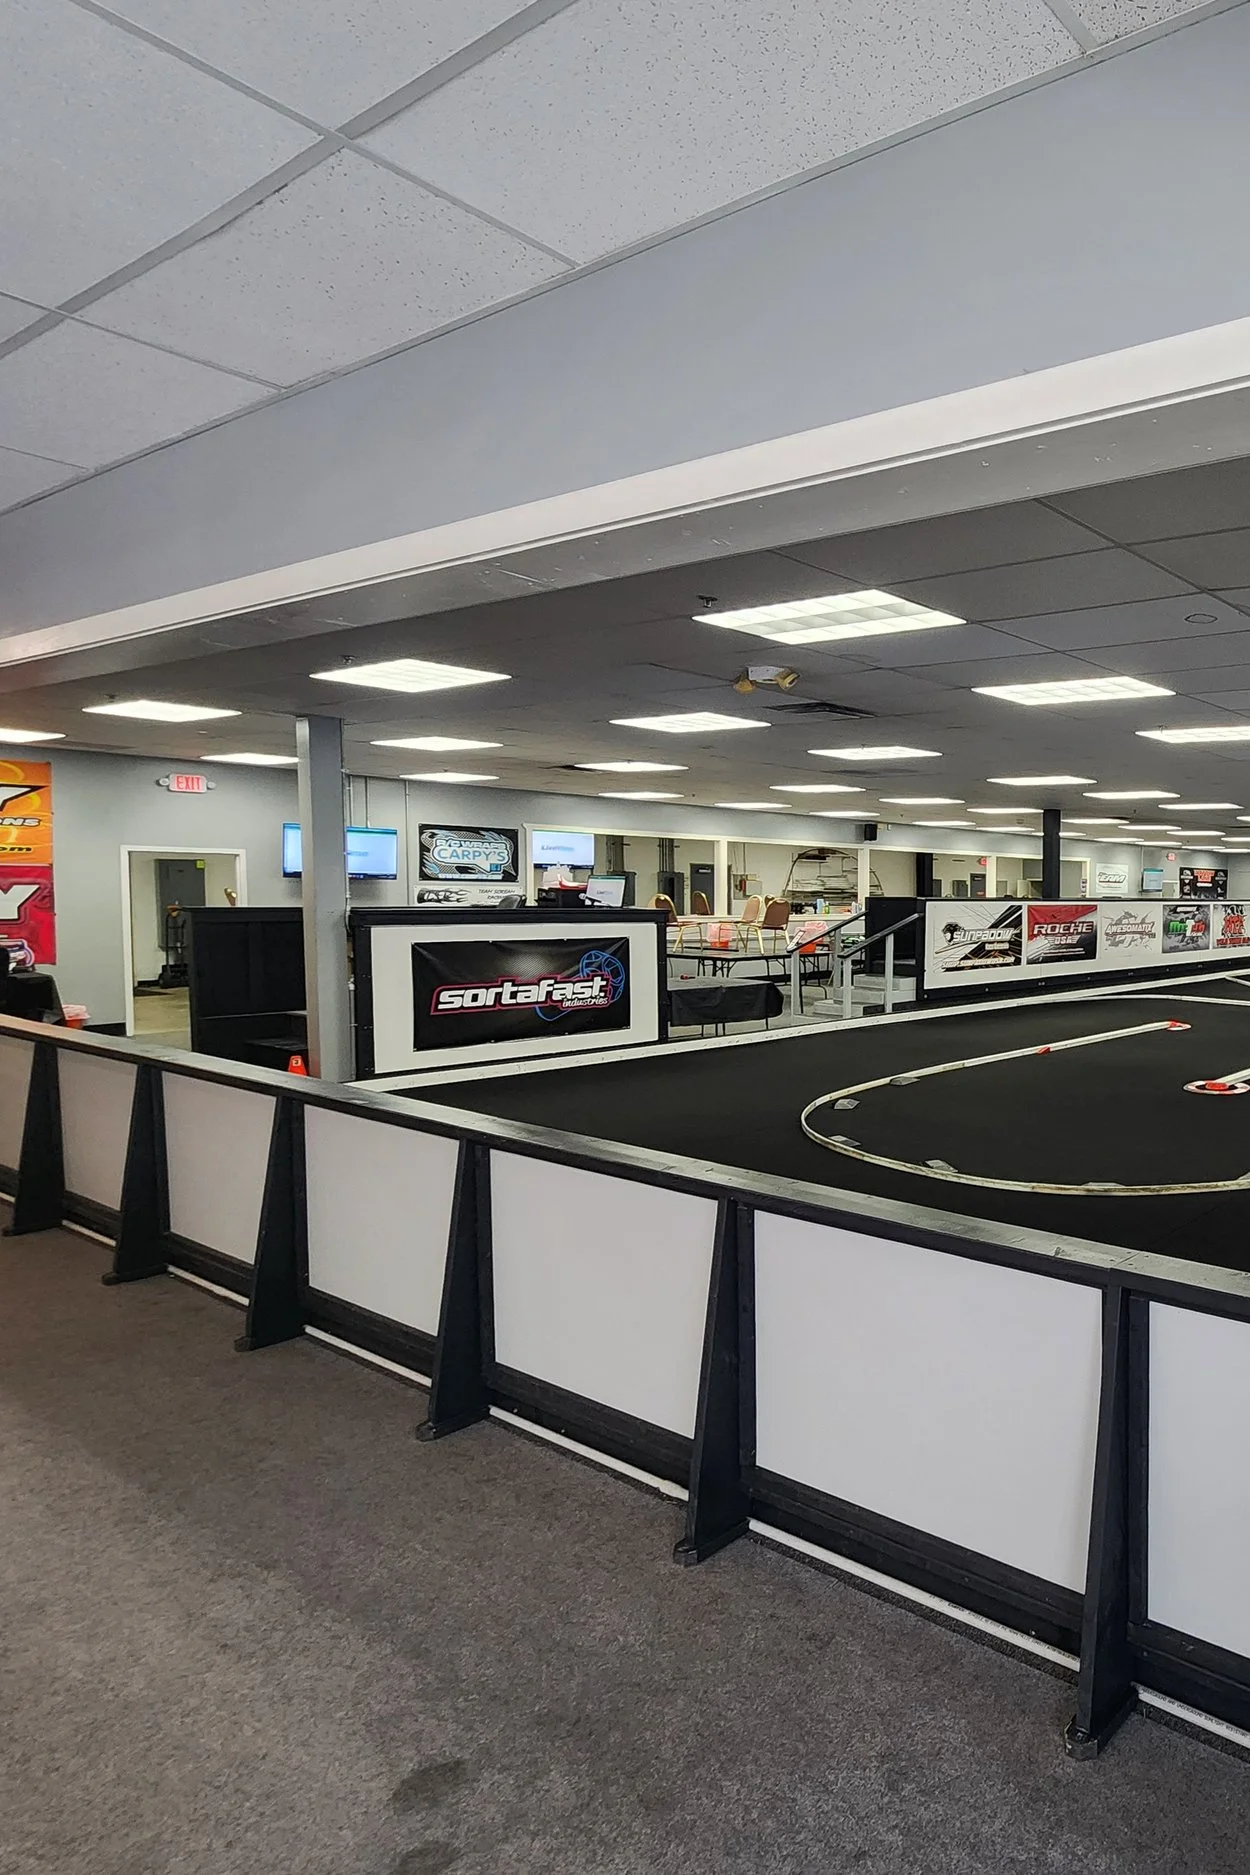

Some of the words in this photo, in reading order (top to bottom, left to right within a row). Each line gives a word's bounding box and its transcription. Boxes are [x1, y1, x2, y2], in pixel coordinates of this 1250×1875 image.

[176, 776, 202, 790] EXIT
[437, 848, 506, 861] CARPY'S
[1034, 921, 1094, 935] ROCHE
[1105, 922, 1155, 934] AWESOMATIX
[438, 976, 607, 1010] sortafast
[562, 995, 609, 1008] industries
